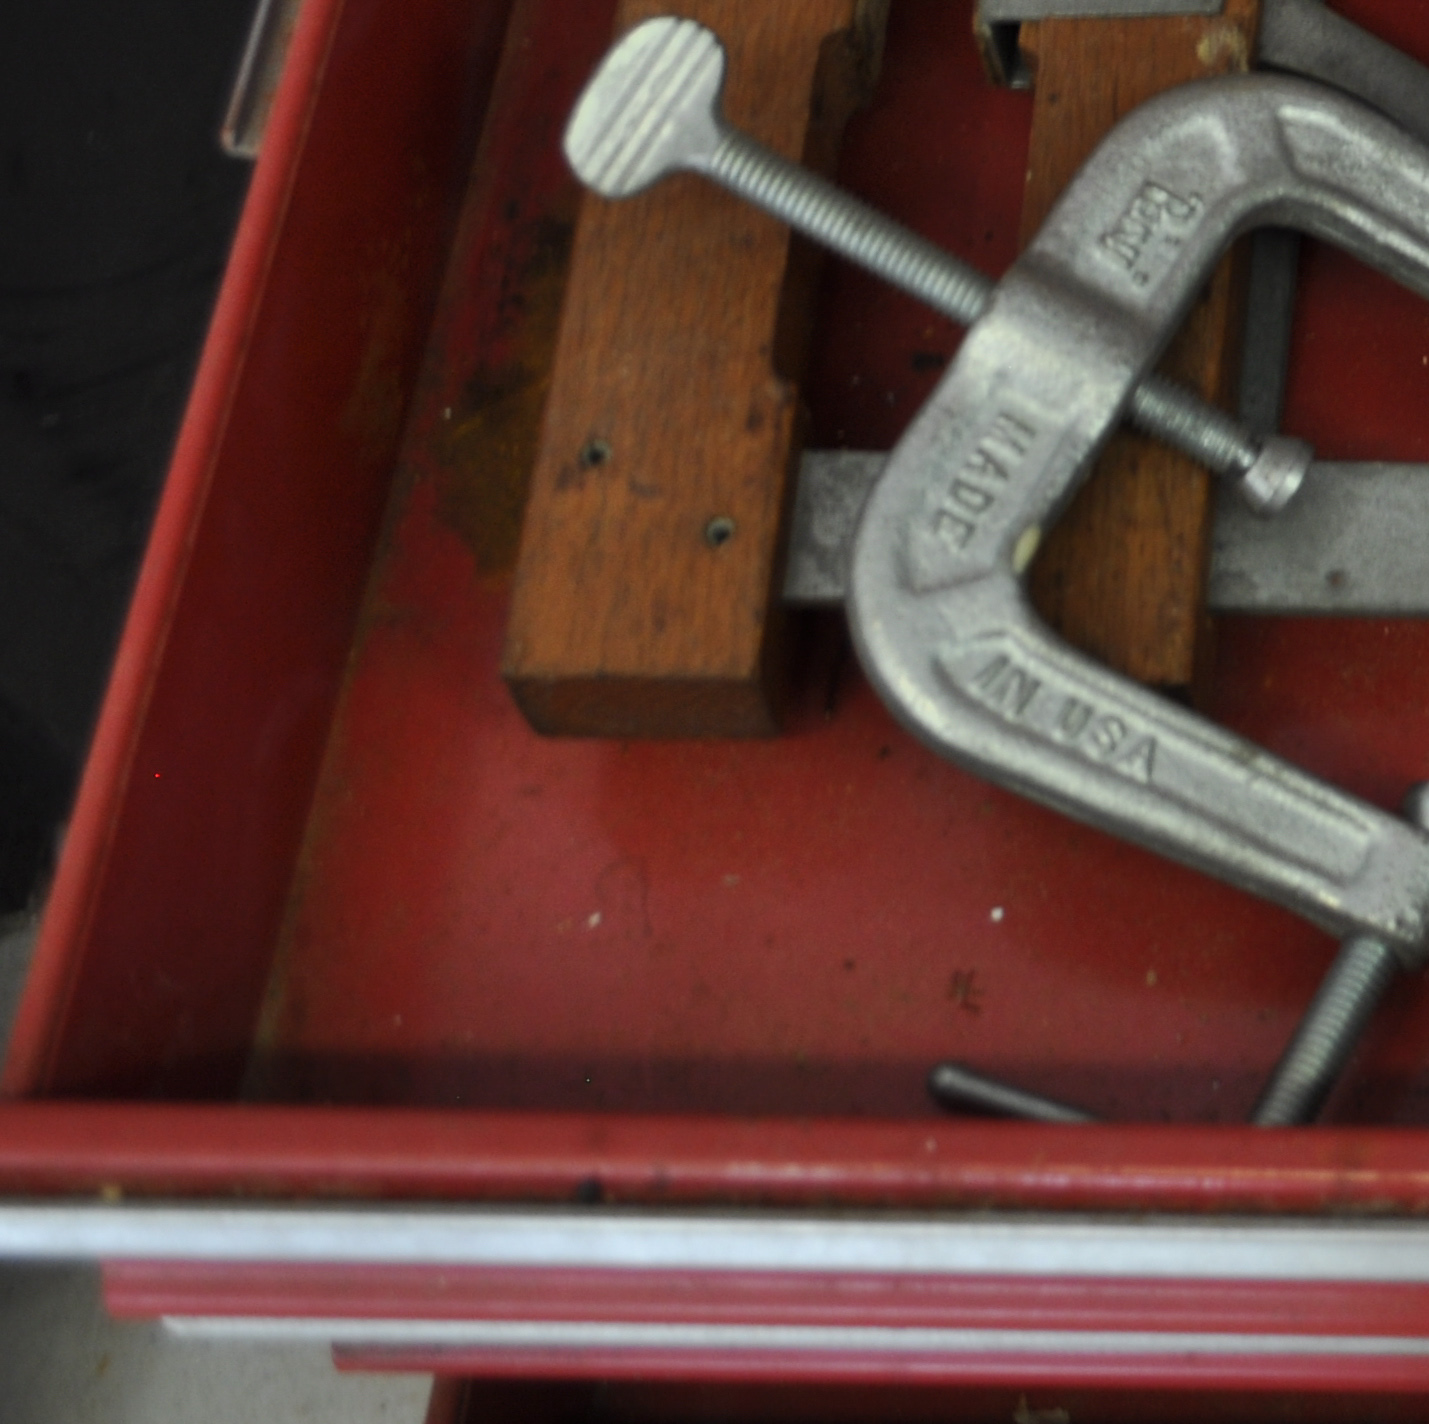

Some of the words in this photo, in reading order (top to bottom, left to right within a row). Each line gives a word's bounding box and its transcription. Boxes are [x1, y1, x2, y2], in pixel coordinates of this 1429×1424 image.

[934, 413, 1036, 550] MADE
[976, 655, 1041, 717] IN
[1058, 697, 1157, 778] USA
